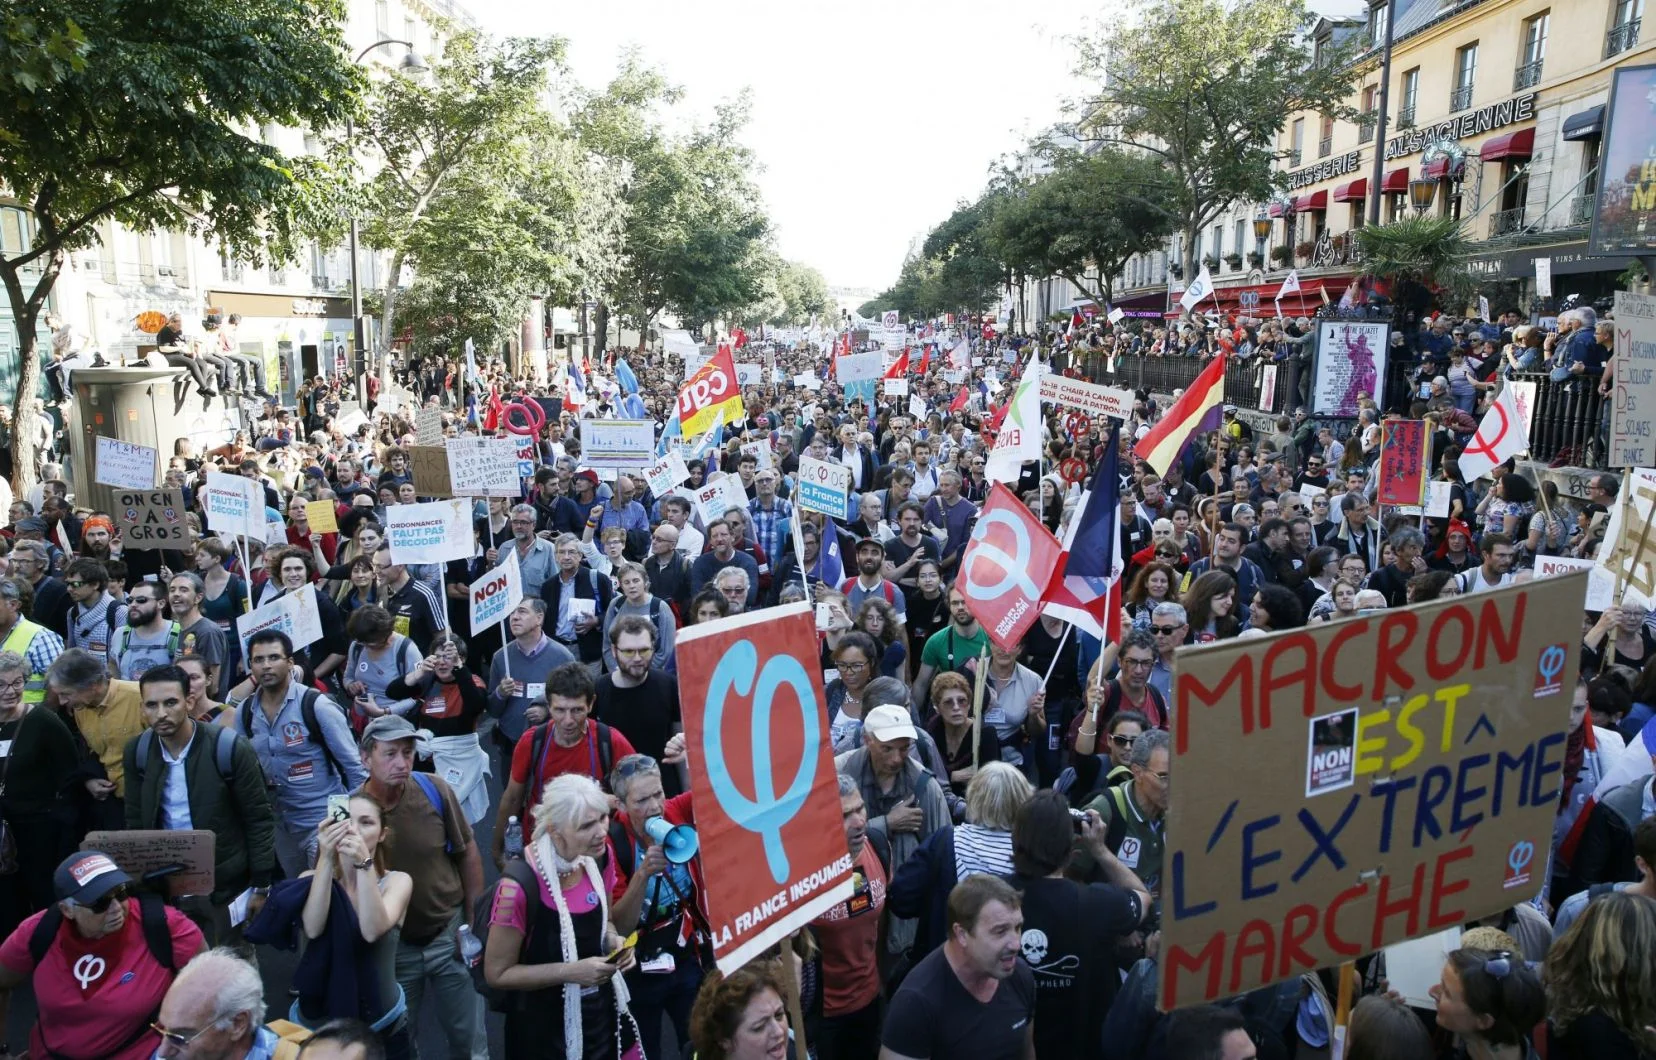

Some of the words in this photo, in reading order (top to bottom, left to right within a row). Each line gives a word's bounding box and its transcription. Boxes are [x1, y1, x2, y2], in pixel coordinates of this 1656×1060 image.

[1284, 150, 1361, 190] RASSERIE
[1384, 92, 1539, 161] ALSACIENNE
[1058, 393, 1082, 404] CHAIR
[1090, 401, 1121, 415] PATRON
[1061, 385, 1084, 397] CHAIR
[1092, 392, 1121, 405] CANON
[121, 494, 146, 506] ON
[211, 495, 234, 506] FAUT
[699, 487, 717, 504] ISF
[799, 493, 844, 516] insoumise
[800, 483, 810, 494] La
[812, 487, 844, 505] France
[145, 508, 159, 523] A
[130, 525, 182, 540] GROS
[393, 528, 421, 539] FAUT
[424, 525, 445, 535] PAS
[474, 573, 508, 604] NON
[475, 603, 506, 625] MEDEF
[1177, 592, 1528, 756] MACRON
[1355, 684, 1472, 776] EST
[1313, 746, 1351, 773] NON
[1171, 712, 1566, 921] L'EXTRÊME
[711, 924, 733, 950] LA
[735, 892, 789, 936] FRANCE
[789, 852, 854, 903] INSOUMISE
[1162, 814, 1475, 1011] MARCHÉ
